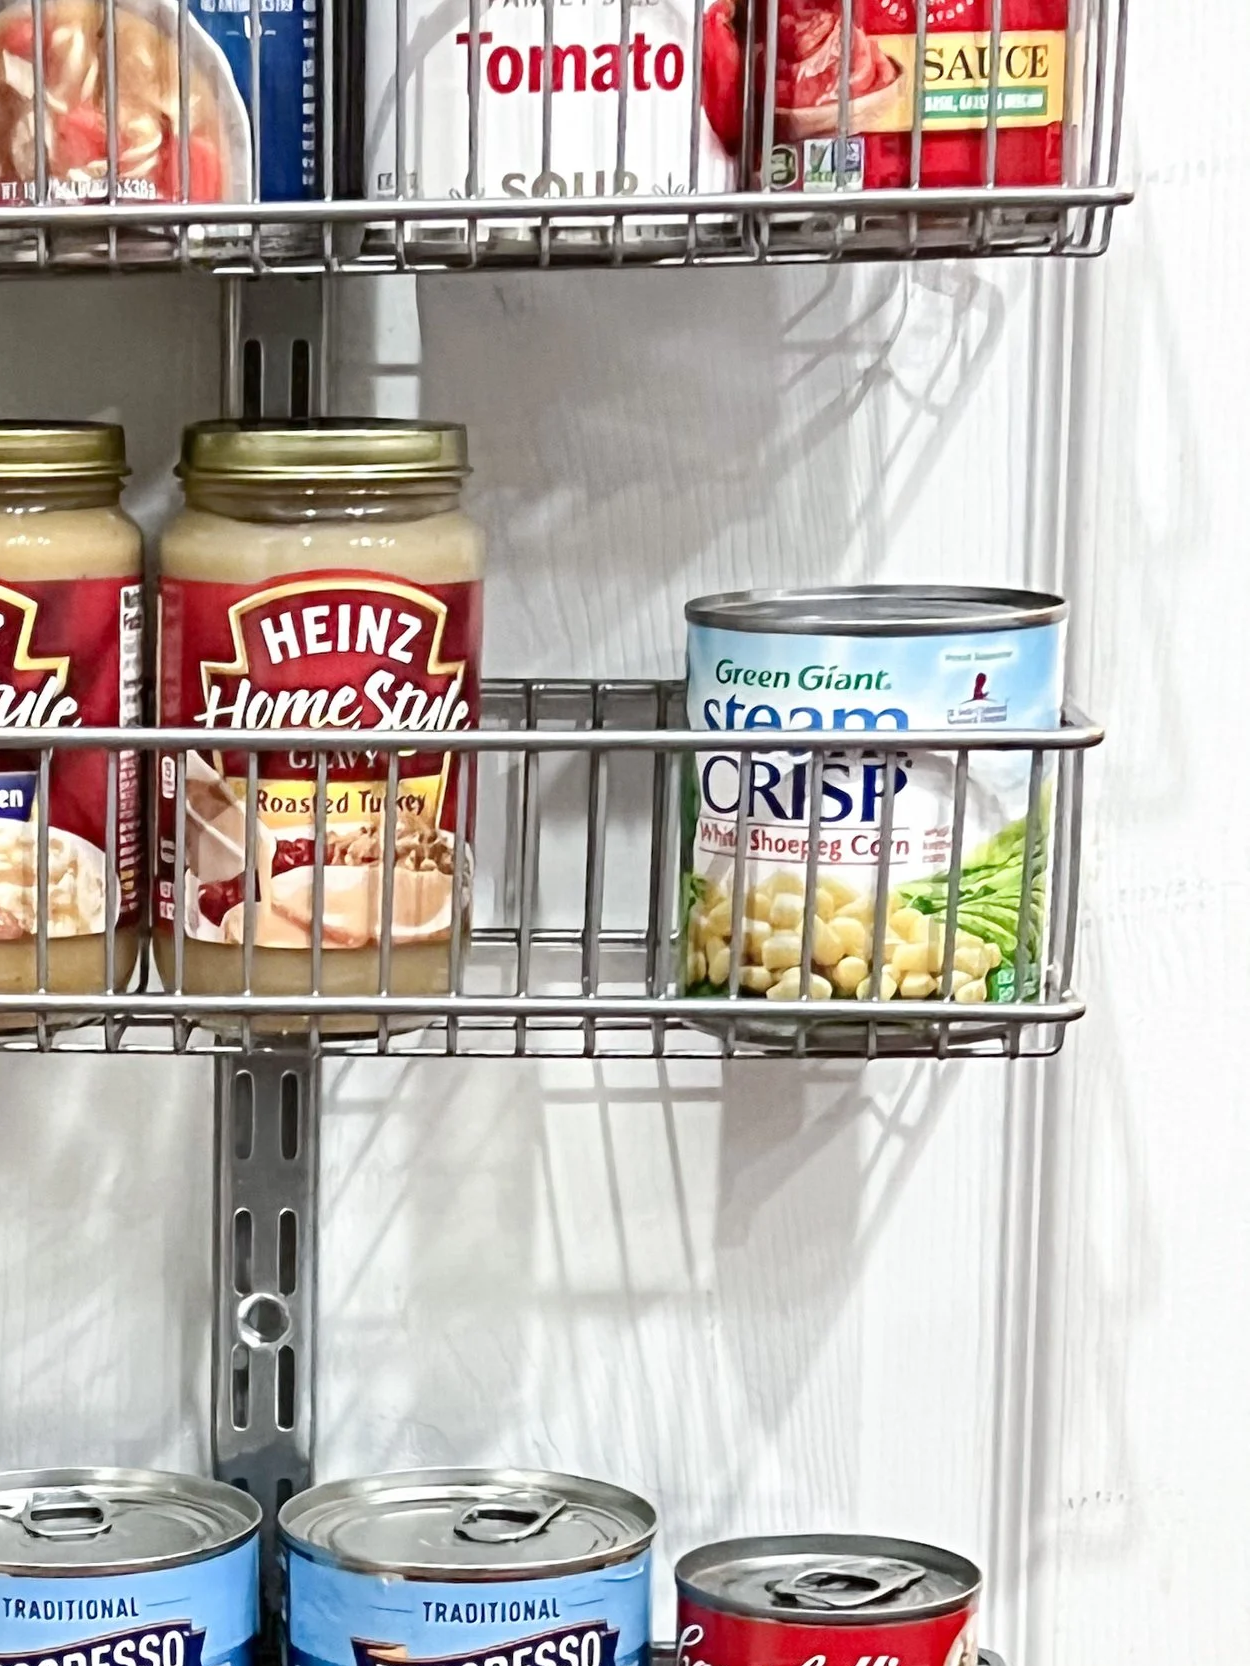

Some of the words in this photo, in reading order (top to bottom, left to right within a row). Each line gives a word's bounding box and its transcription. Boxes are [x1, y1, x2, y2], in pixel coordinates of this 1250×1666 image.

[455, 31, 685, 95] Tomato
[922, 44, 1050, 82] SAUCE
[260, 604, 423, 664] HEINZ
[715, 658, 791, 689] Green
[797, 664, 890, 691] Giant
[703, 693, 909, 733] steam
[256, 789, 349, 814] Roased
[358, 790, 428, 817] Tukey
[702, 754, 908, 823] CRISP
[700, 821, 738, 848] Whit
[851, 834, 910, 856] Con
[2, 1597, 140, 1622] TRADITIONAL
[423, 1597, 561, 1624] TRADITIONAL
